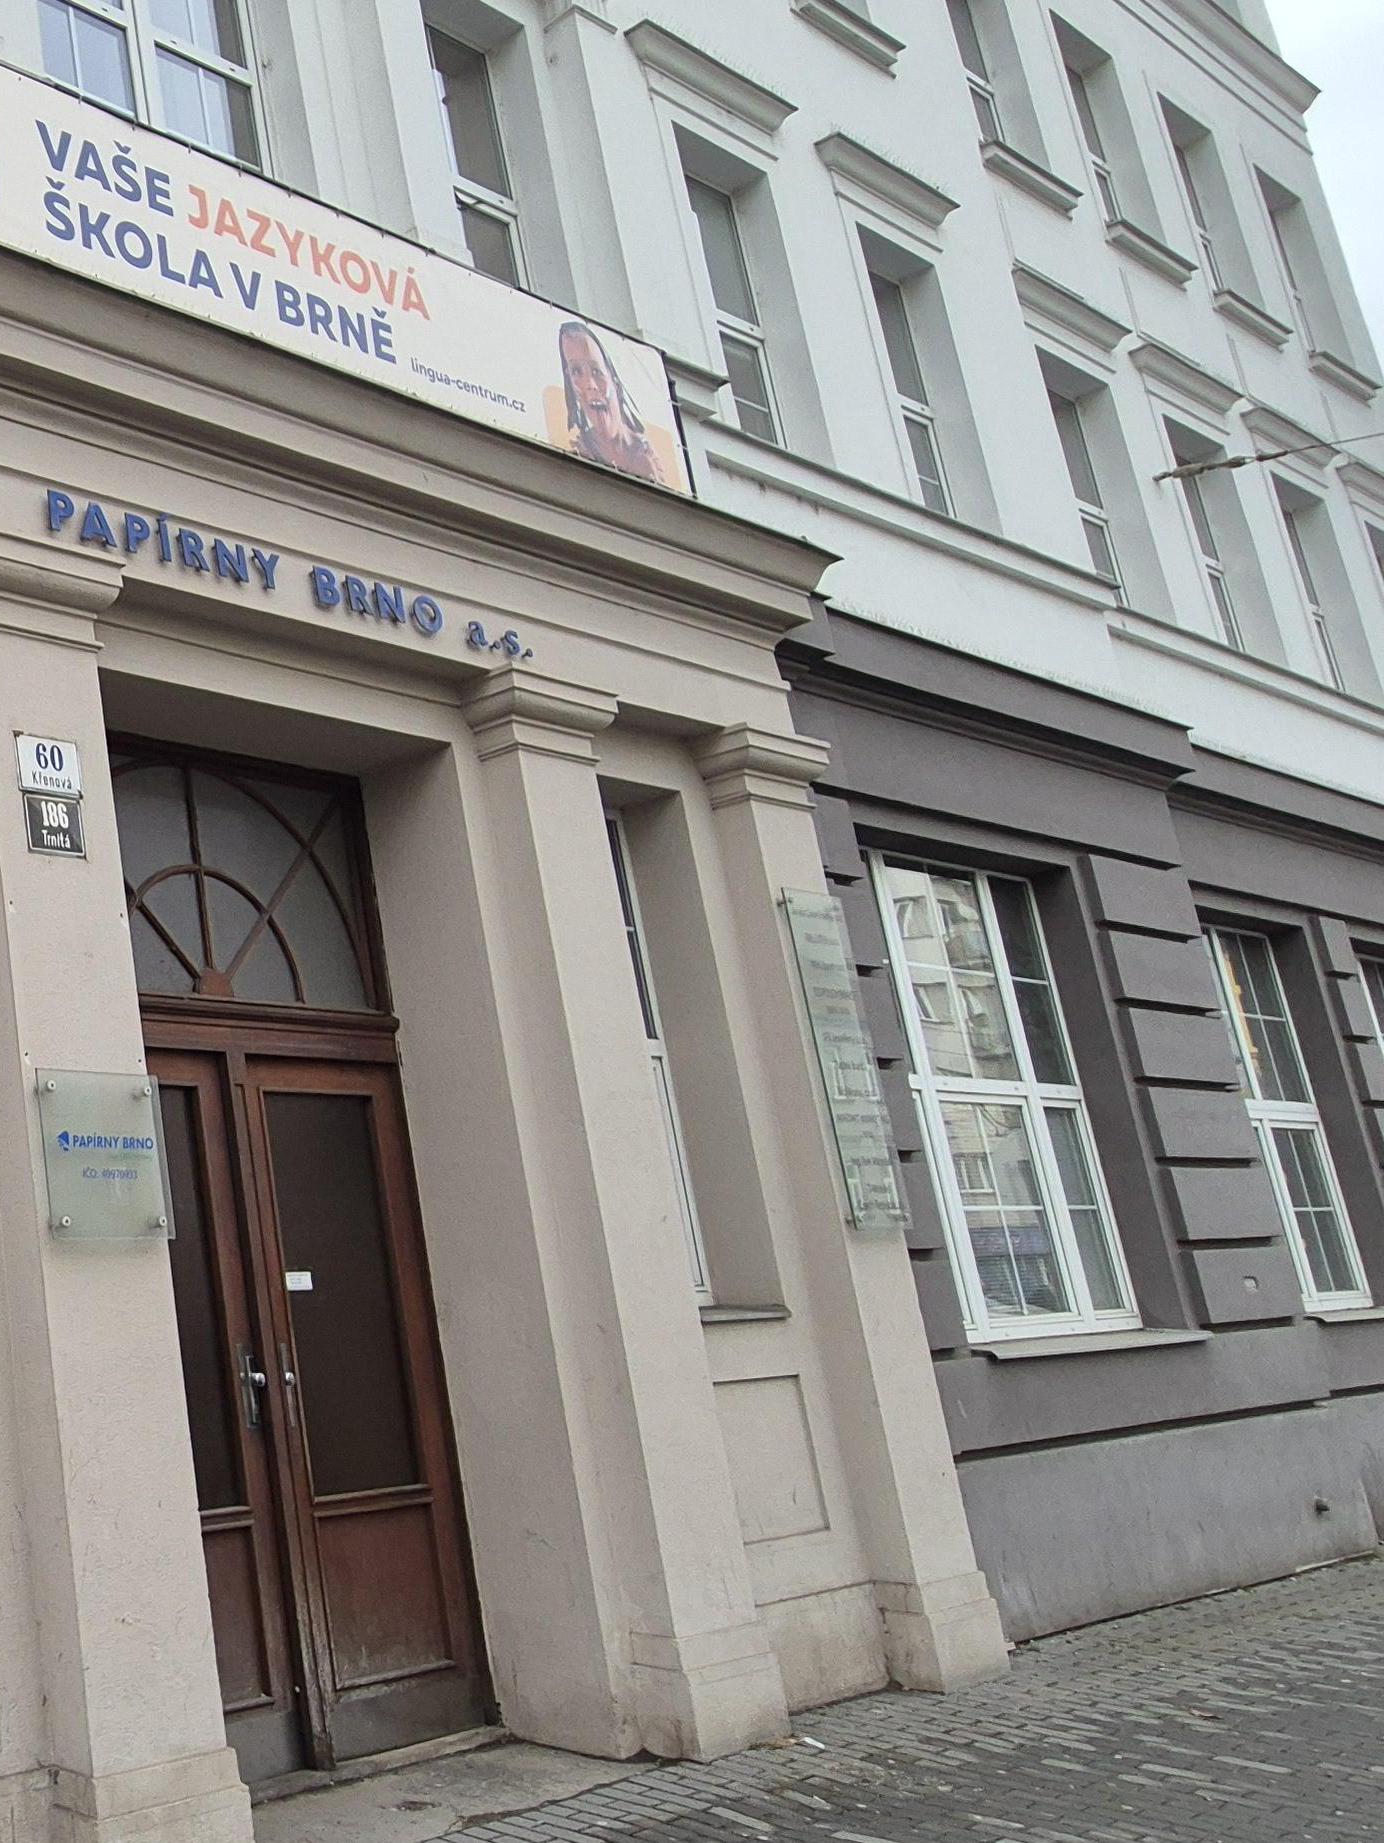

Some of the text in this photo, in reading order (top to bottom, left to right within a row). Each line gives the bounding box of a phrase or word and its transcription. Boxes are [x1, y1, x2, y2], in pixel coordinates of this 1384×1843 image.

[36, 119, 431, 320] VAŠE JAZYKOVÁ
[44, 176, 397, 365] ŠKOLA V BRNĚ
[410, 357, 527, 413] lingua-centrum.cz
[46, 489, 534, 659] PAPÍRNY BRNO a.s.
[35, 743, 64, 772] 60
[31, 770, 73, 790] Křenová
[41, 800, 69, 829] 186
[72, 1131, 154, 1150] PAPÍRNY BRNO
